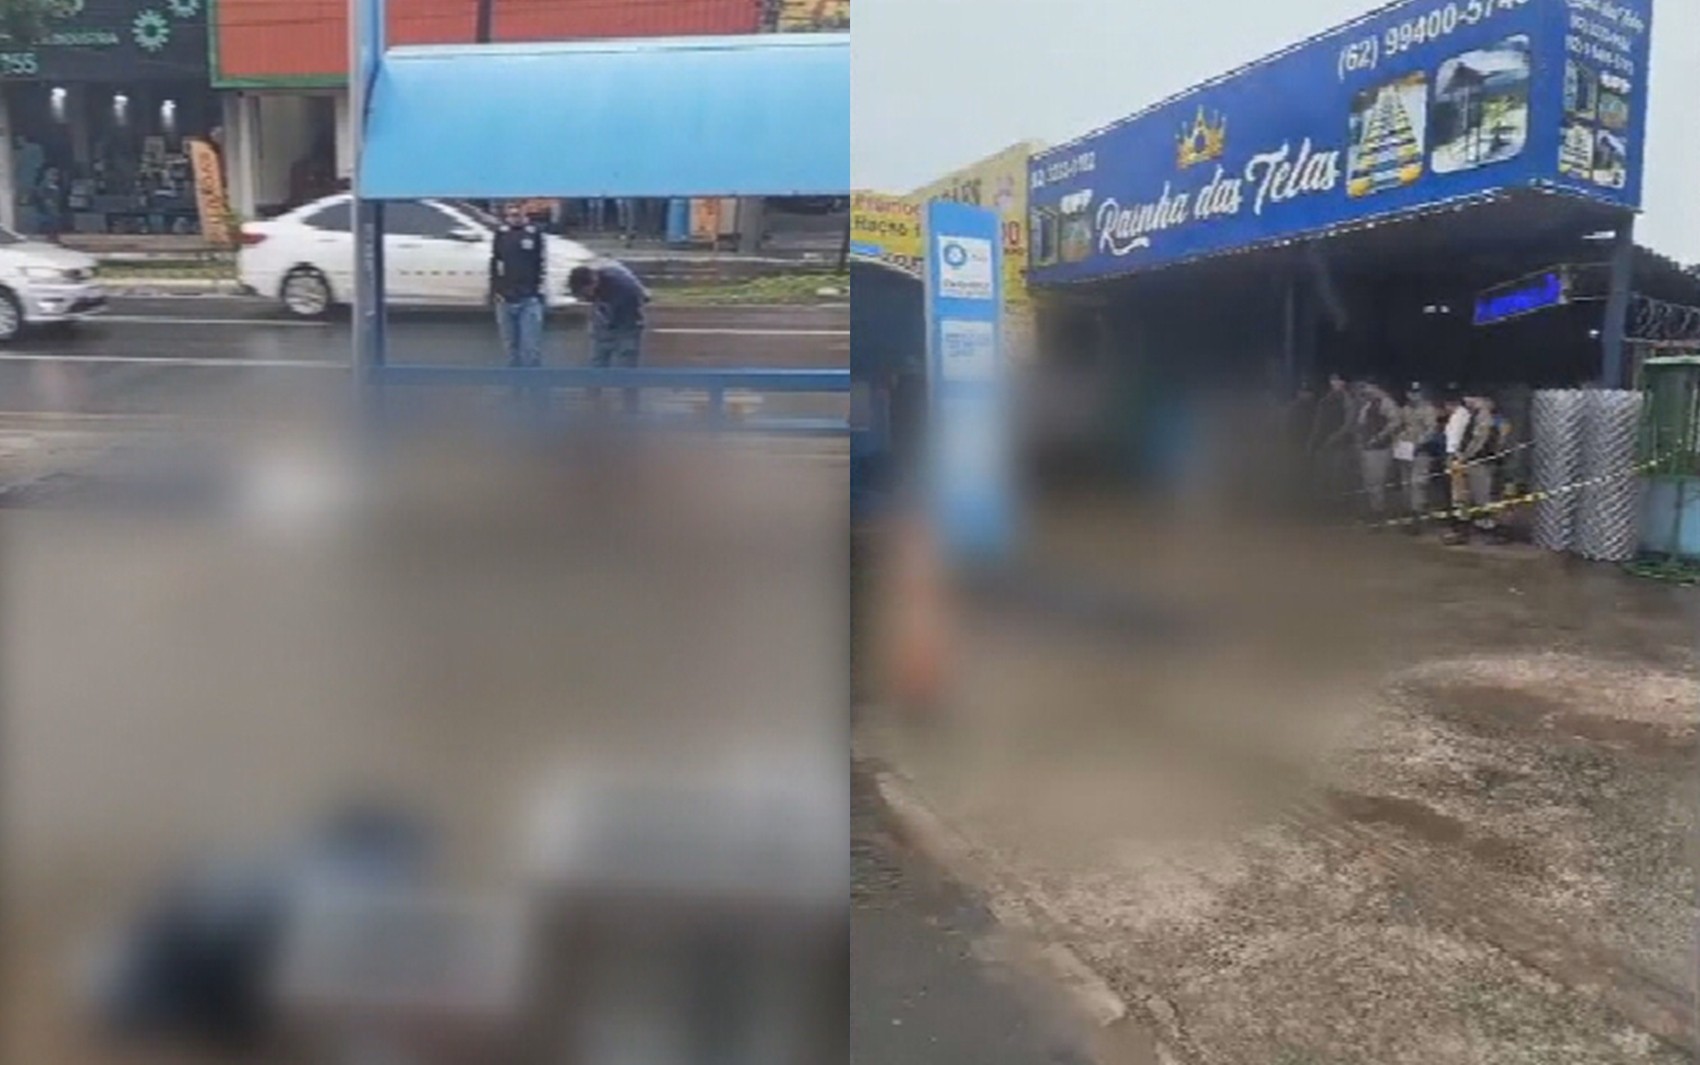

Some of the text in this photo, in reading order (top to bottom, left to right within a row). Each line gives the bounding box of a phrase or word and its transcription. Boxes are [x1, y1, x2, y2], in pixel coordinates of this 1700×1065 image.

[1338, 35, 1379, 82] (62)
[1384, 0, 1528, 56] 99400-57
[1096, 137, 1341, 256] Rainha das Telas
